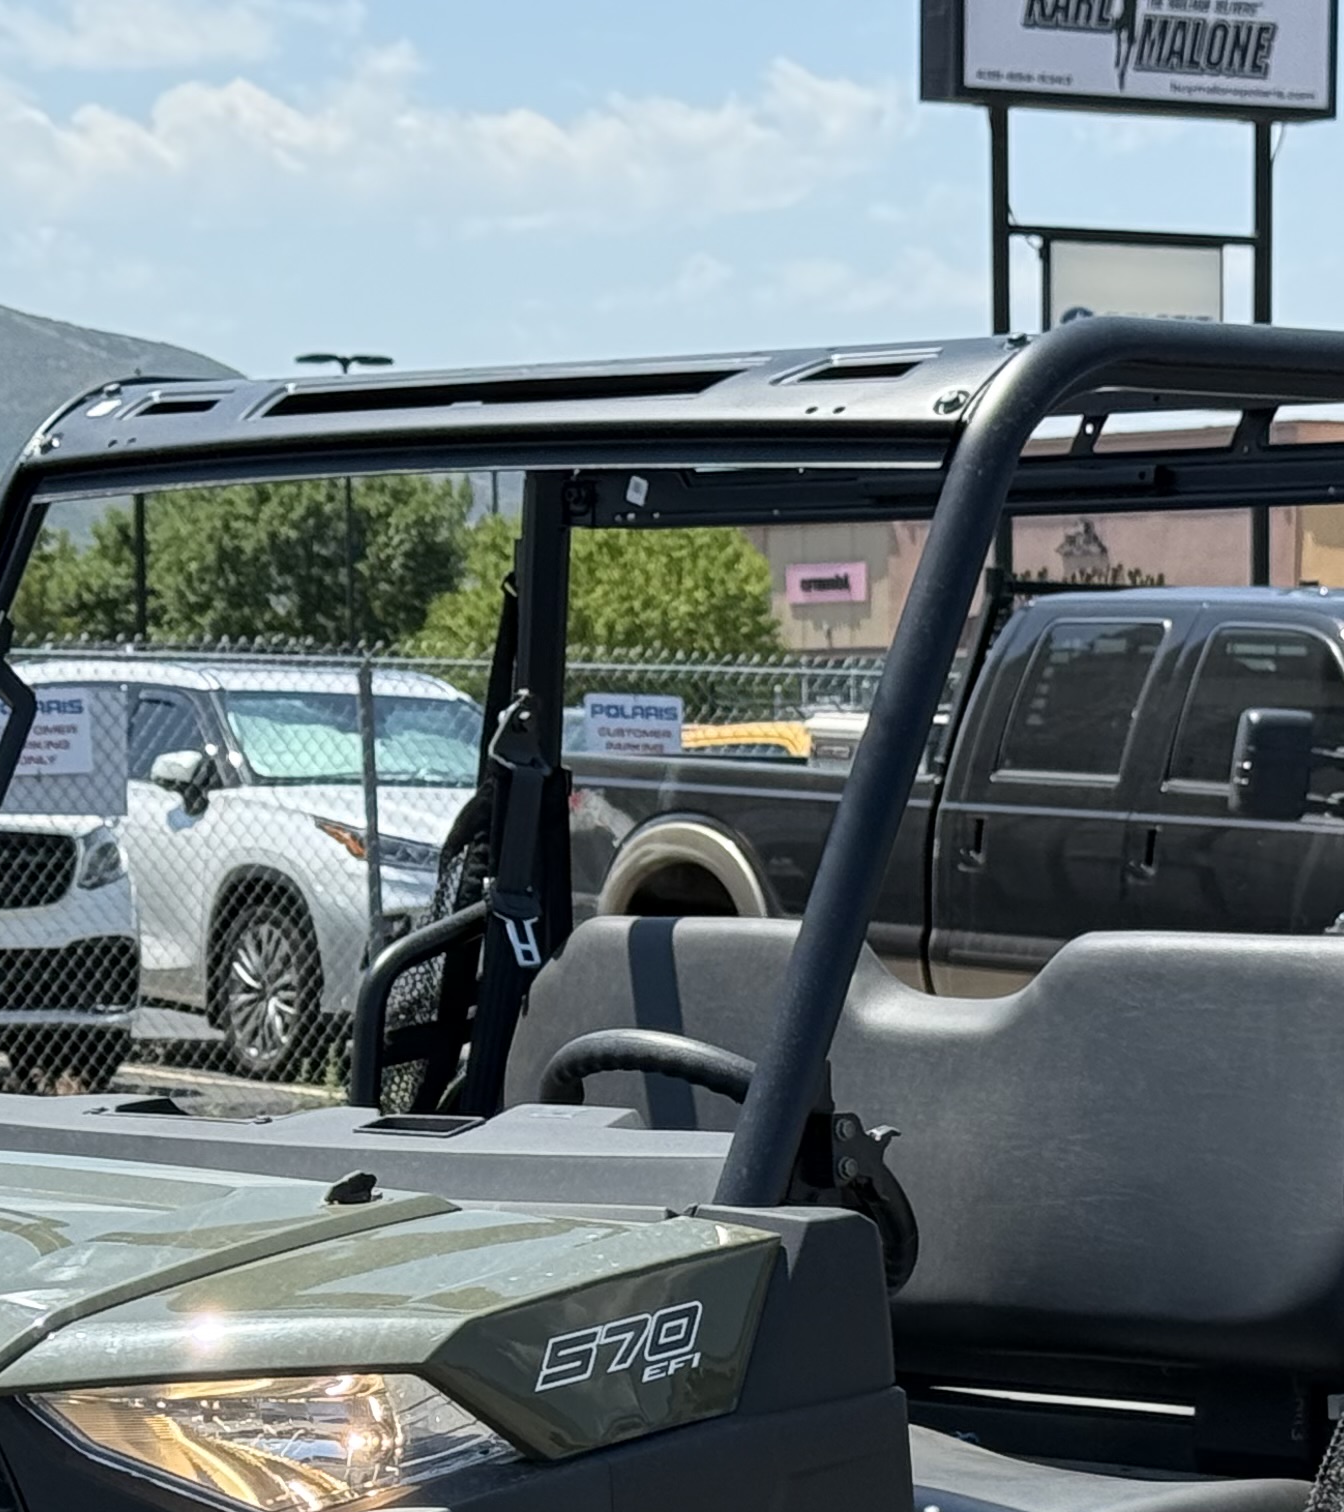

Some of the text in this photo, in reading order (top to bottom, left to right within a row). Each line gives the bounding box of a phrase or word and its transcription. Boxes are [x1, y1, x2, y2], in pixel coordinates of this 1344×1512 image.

[1134, 14, 1278, 80] MALONE
[590, 703, 678, 721] POLARIS
[598, 727, 672, 739] CUSTOMER
[534, 1300, 704, 1393] 570
[641, 1351, 701, 1384] EFI
